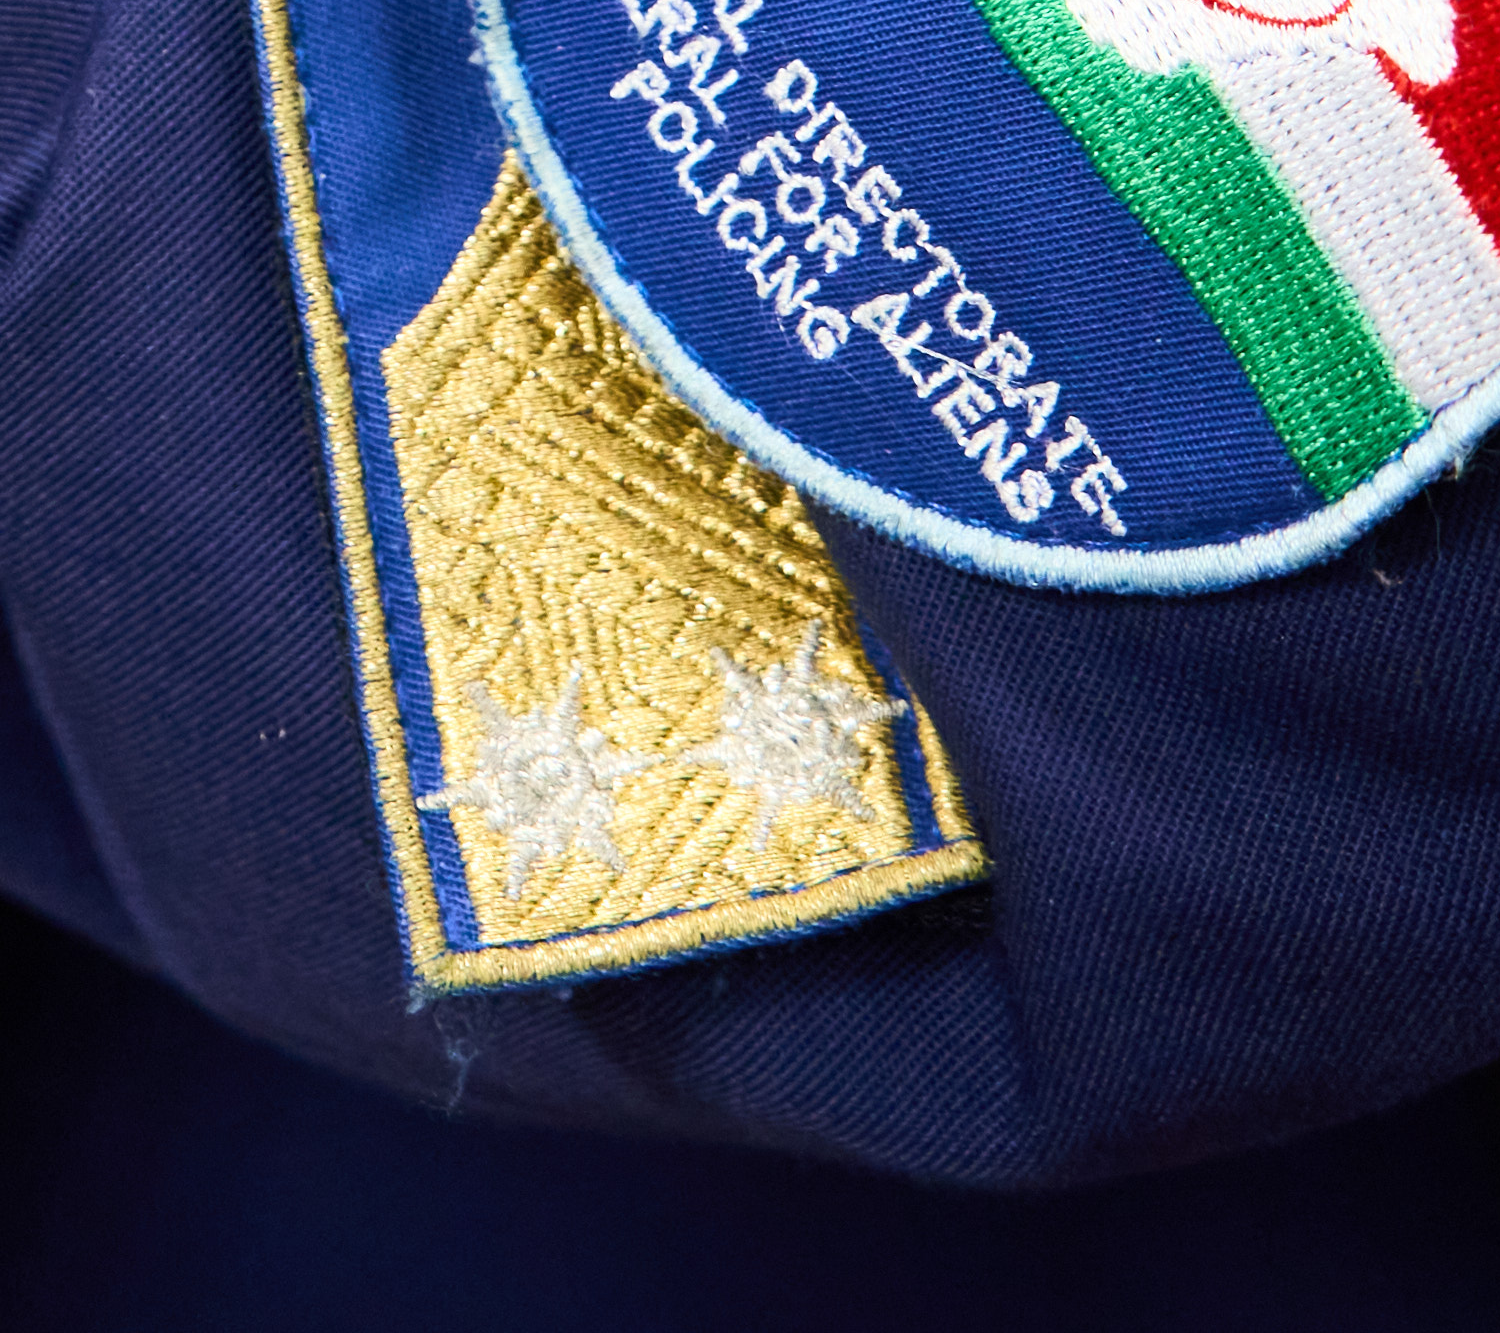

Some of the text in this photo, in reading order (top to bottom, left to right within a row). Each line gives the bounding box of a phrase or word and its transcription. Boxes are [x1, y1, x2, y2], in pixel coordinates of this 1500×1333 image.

[611, 59, 851, 360] POLICING
[741, 132, 859, 272] FOR
[853, 293, 1055, 523] ALIENS
